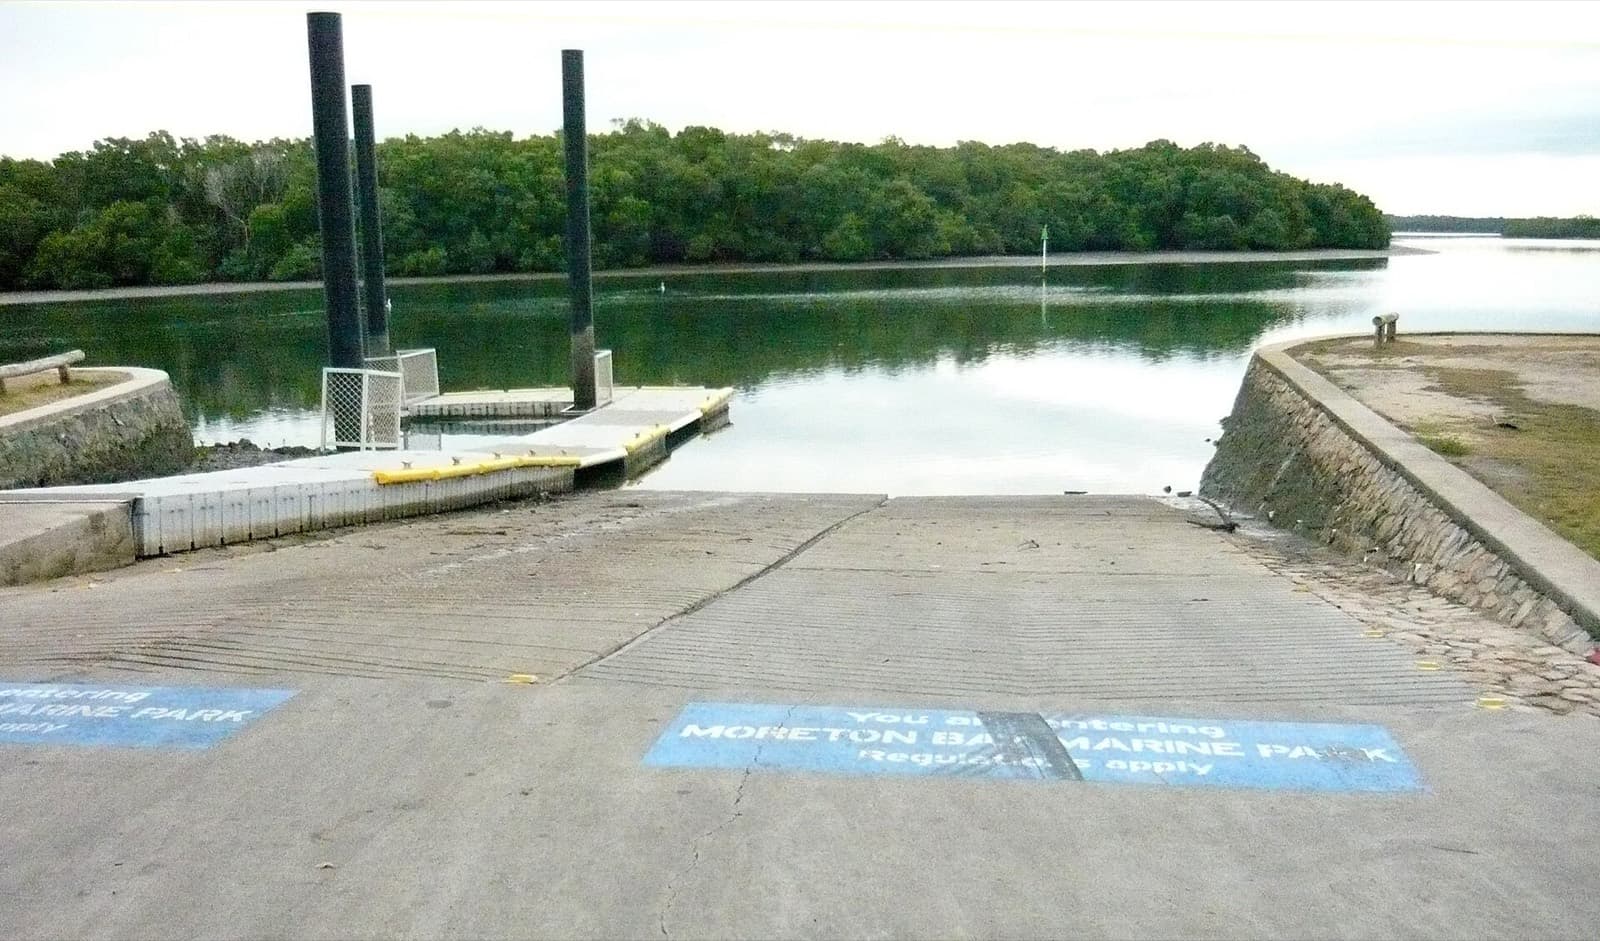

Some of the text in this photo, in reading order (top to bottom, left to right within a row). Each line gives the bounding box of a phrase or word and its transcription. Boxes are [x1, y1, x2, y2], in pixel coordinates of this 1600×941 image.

[130, 707, 252, 722] PARK
[846, 711, 929, 724] You
[679, 724, 1399, 763] MORETON BA MARINE PAK
[1105, 759, 1214, 776] apply
